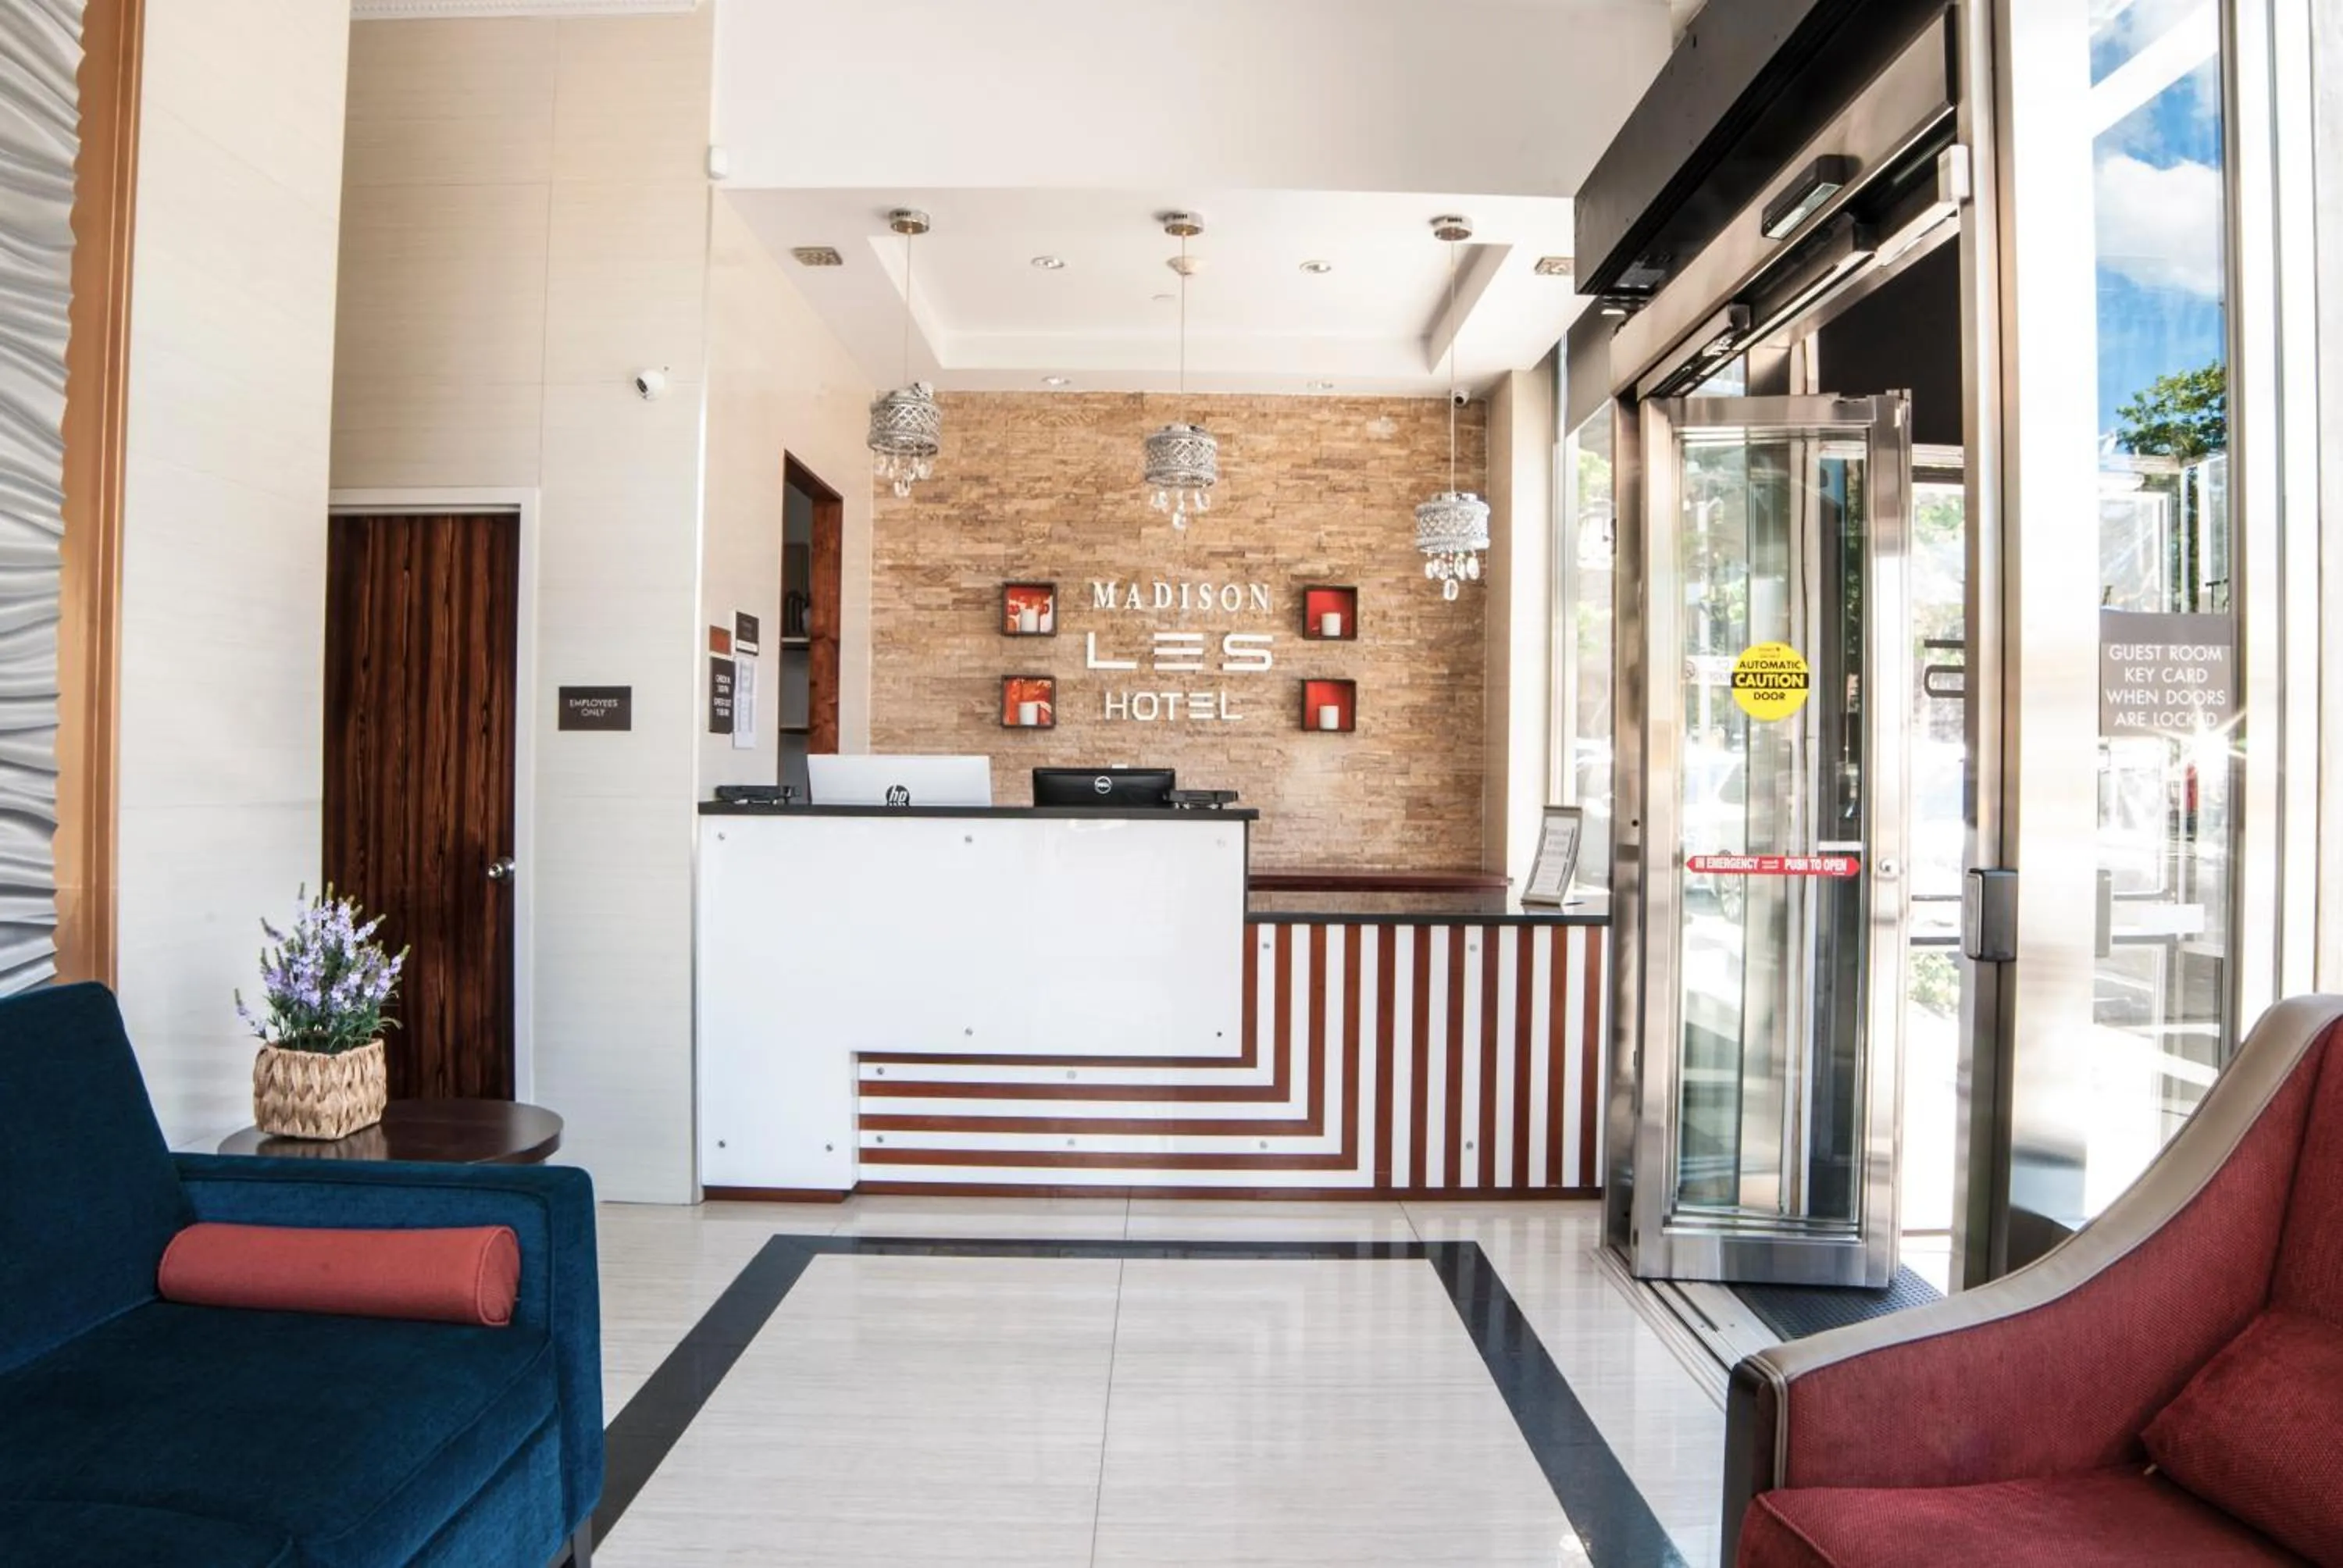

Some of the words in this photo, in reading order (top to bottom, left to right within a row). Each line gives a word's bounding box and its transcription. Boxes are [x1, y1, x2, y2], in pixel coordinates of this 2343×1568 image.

[1093, 581, 1271, 611] MADISON
[1086, 632, 1274, 672] LES
[2109, 645, 2163, 661] GUEST
[2169, 646, 2223, 661] ROOM
[1739, 660, 1801, 670] AUTOMATIC
[1735, 673, 1805, 688] CAUTION
[2124, 667, 2156, 683] KEY
[2161, 668, 2209, 683] CARD
[569, 699, 618, 707] EMPLOYEES
[1753, 691, 1786, 701] DOOR
[2105, 690, 2159, 705] WHEN
[2166, 690, 2226, 706] DOORS
[580, 708, 605, 717] ONLY
[1104, 691, 1243, 722] HOTEL
[2114, 711, 2146, 727] ARE
[2153, 711, 2218, 727] LOCKD
[1706, 857, 1760, 869] EMERGENCY
[1785, 858, 1808, 871] PUSH
[1810, 859, 1822, 871] TO
[1824, 859, 1847, 872] OPEN
